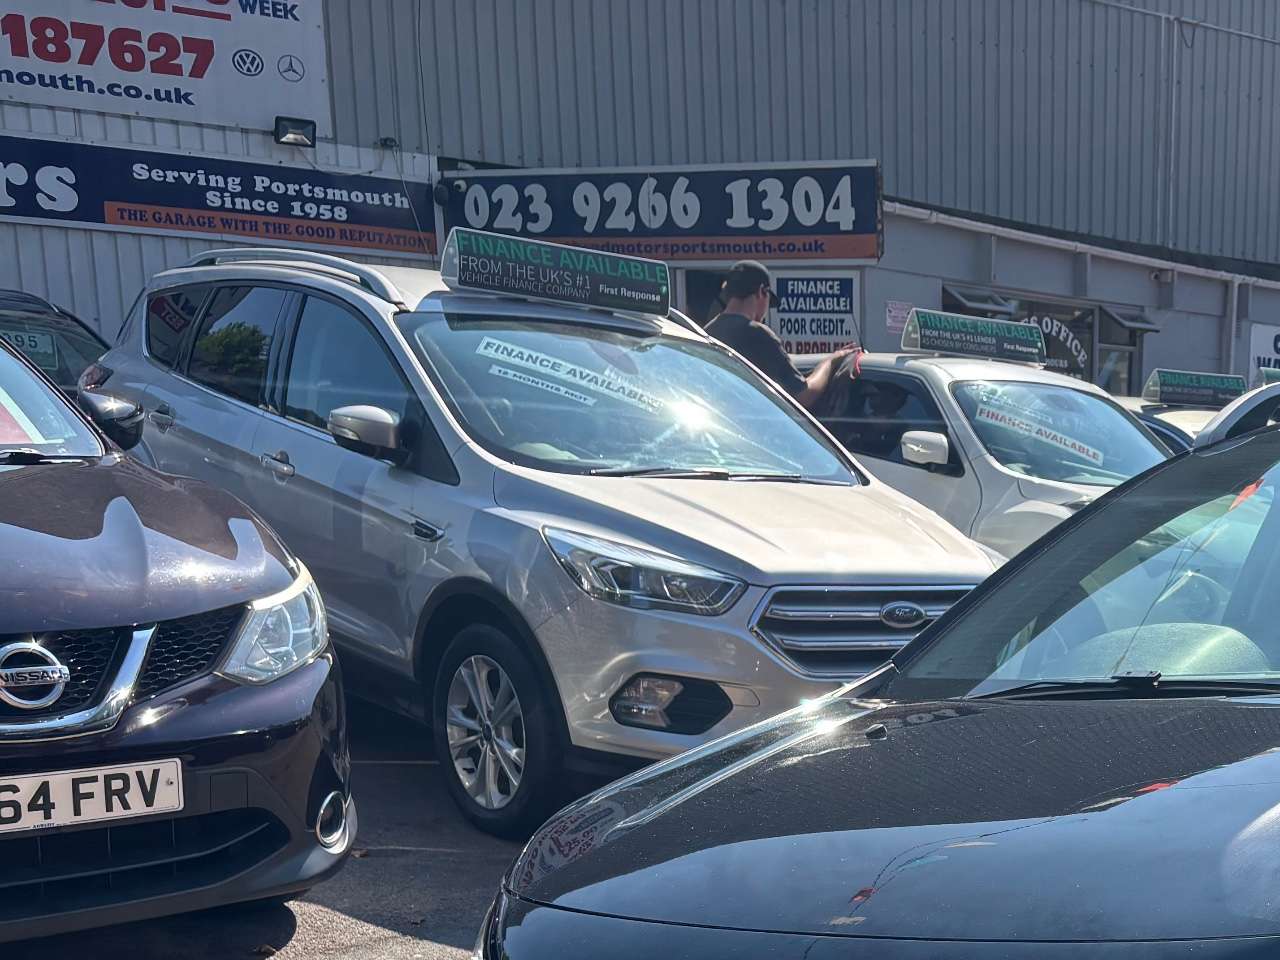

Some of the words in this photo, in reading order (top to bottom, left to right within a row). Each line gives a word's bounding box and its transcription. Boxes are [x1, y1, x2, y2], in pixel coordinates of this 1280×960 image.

[238, 0, 300, 21] WEEK
[0, 13, 215, 79] 187627
[132, 163, 242, 193] Serving
[254, 175, 410, 209] Portsmouth
[206, 191, 279, 213] Since
[290, 201, 348, 222] 1958
[464, 183, 552, 233] 023
[572, 176, 701, 234] 9266
[725, 174, 856, 232] 1304
[117, 207, 149, 223] THE
[152, 211, 217, 230] GARAGE
[220, 217, 259, 234] WITH
[263, 221, 293, 236] THE
[296, 225, 336, 241] GOOD
[458, 233, 554, 266] FINANCE
[558, 248, 666, 284] AVAILABLE
[460, 255, 501, 275] FROM
[507, 262, 535, 279] THE
[576, 274, 591, 288] #1
[459, 271, 501, 286] VEHICLE
[503, 277, 546, 293] FINANCE
[547, 283, 591, 299] COMPANY
[599, 284, 618, 295] First
[787, 280, 840, 295] FINANCE
[779, 296, 851, 312] AVAILABLE!
[780, 317, 807, 335] POOR
[809, 318, 851, 336] CREDIT..
[917, 311, 975, 332] FINANCE
[977, 321, 1041, 342] AVAILABLE
[1042, 316, 1088, 368] OFFICE
[484, 341, 561, 372] FINANCE
[1035, 428, 1099, 459] AVAILABLE
[0, 780, 56, 825] 64
[71, 768, 161, 817] FRV
